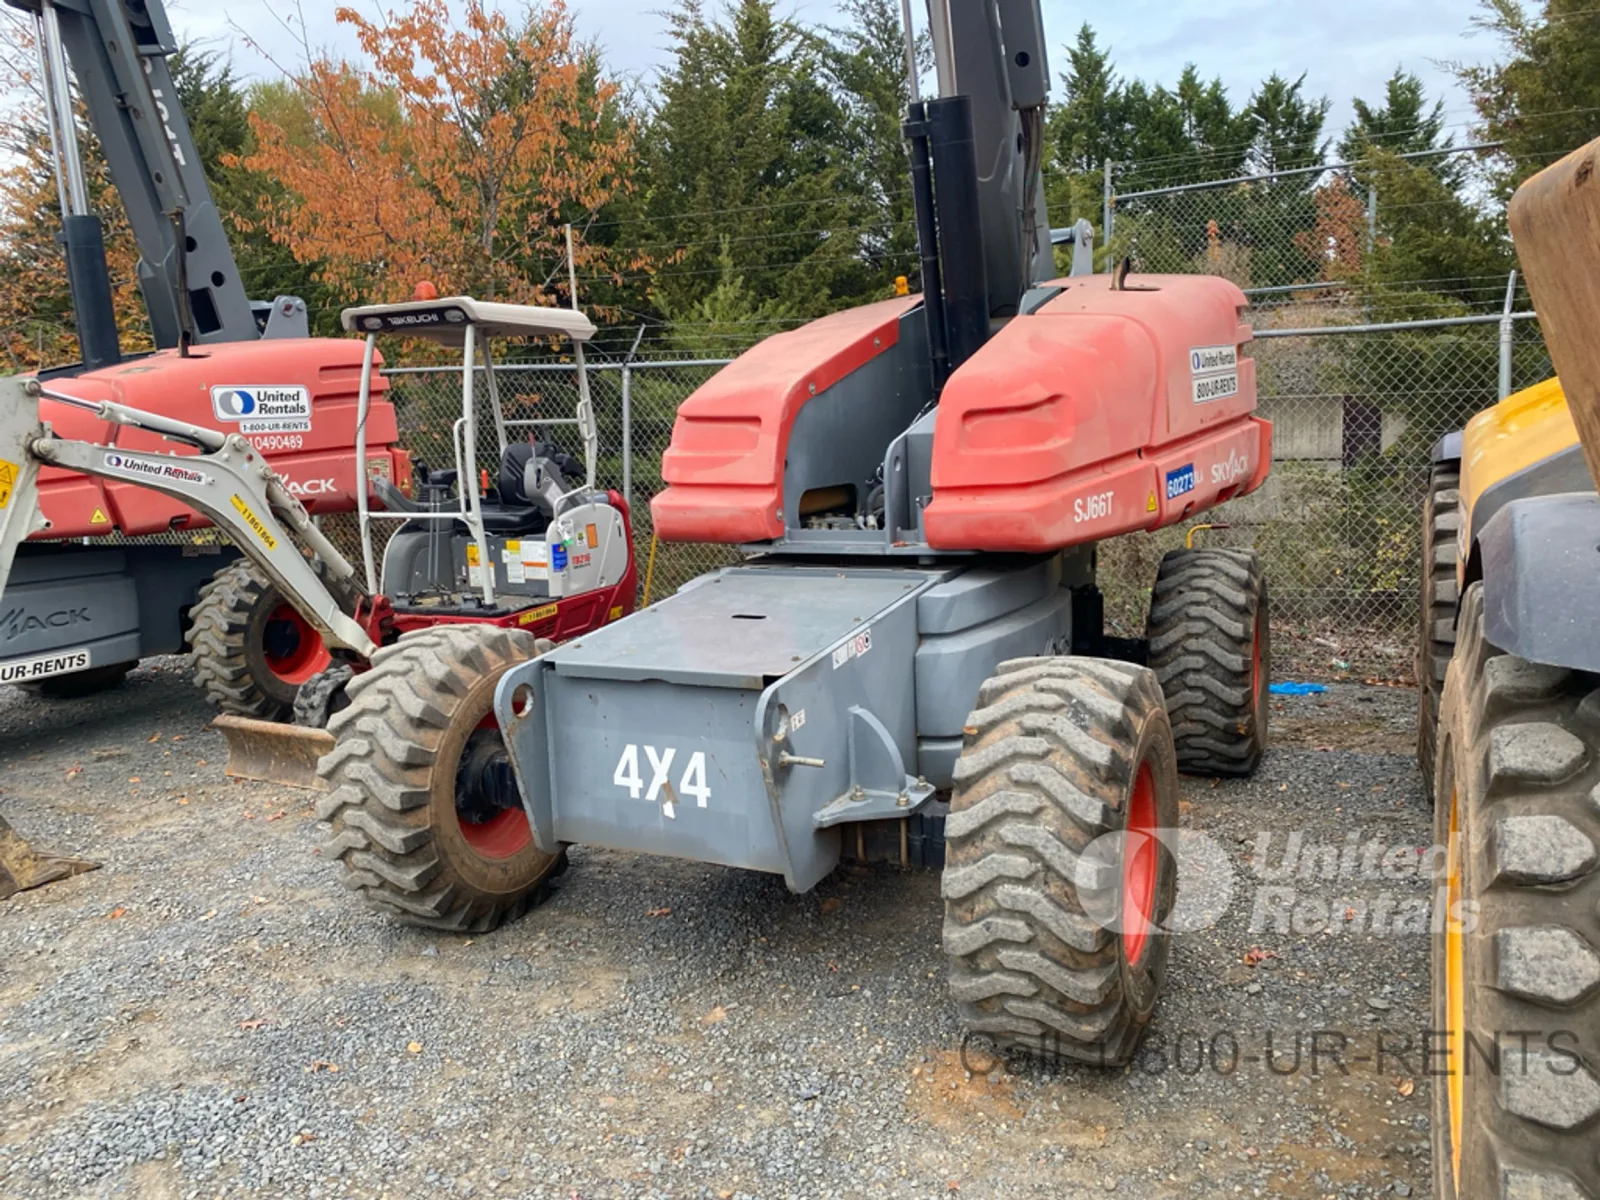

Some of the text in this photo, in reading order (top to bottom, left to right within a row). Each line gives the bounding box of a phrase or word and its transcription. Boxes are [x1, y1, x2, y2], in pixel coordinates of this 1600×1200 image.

[257, 390, 300, 402] United
[259, 402, 306, 415] Rentals
[243, 421, 309, 431] 1-800-UR-RENTS
[123, 458, 162, 475] United
[1074, 491, 1114, 523] SJ66T
[613, 743, 711, 818] 4X4
